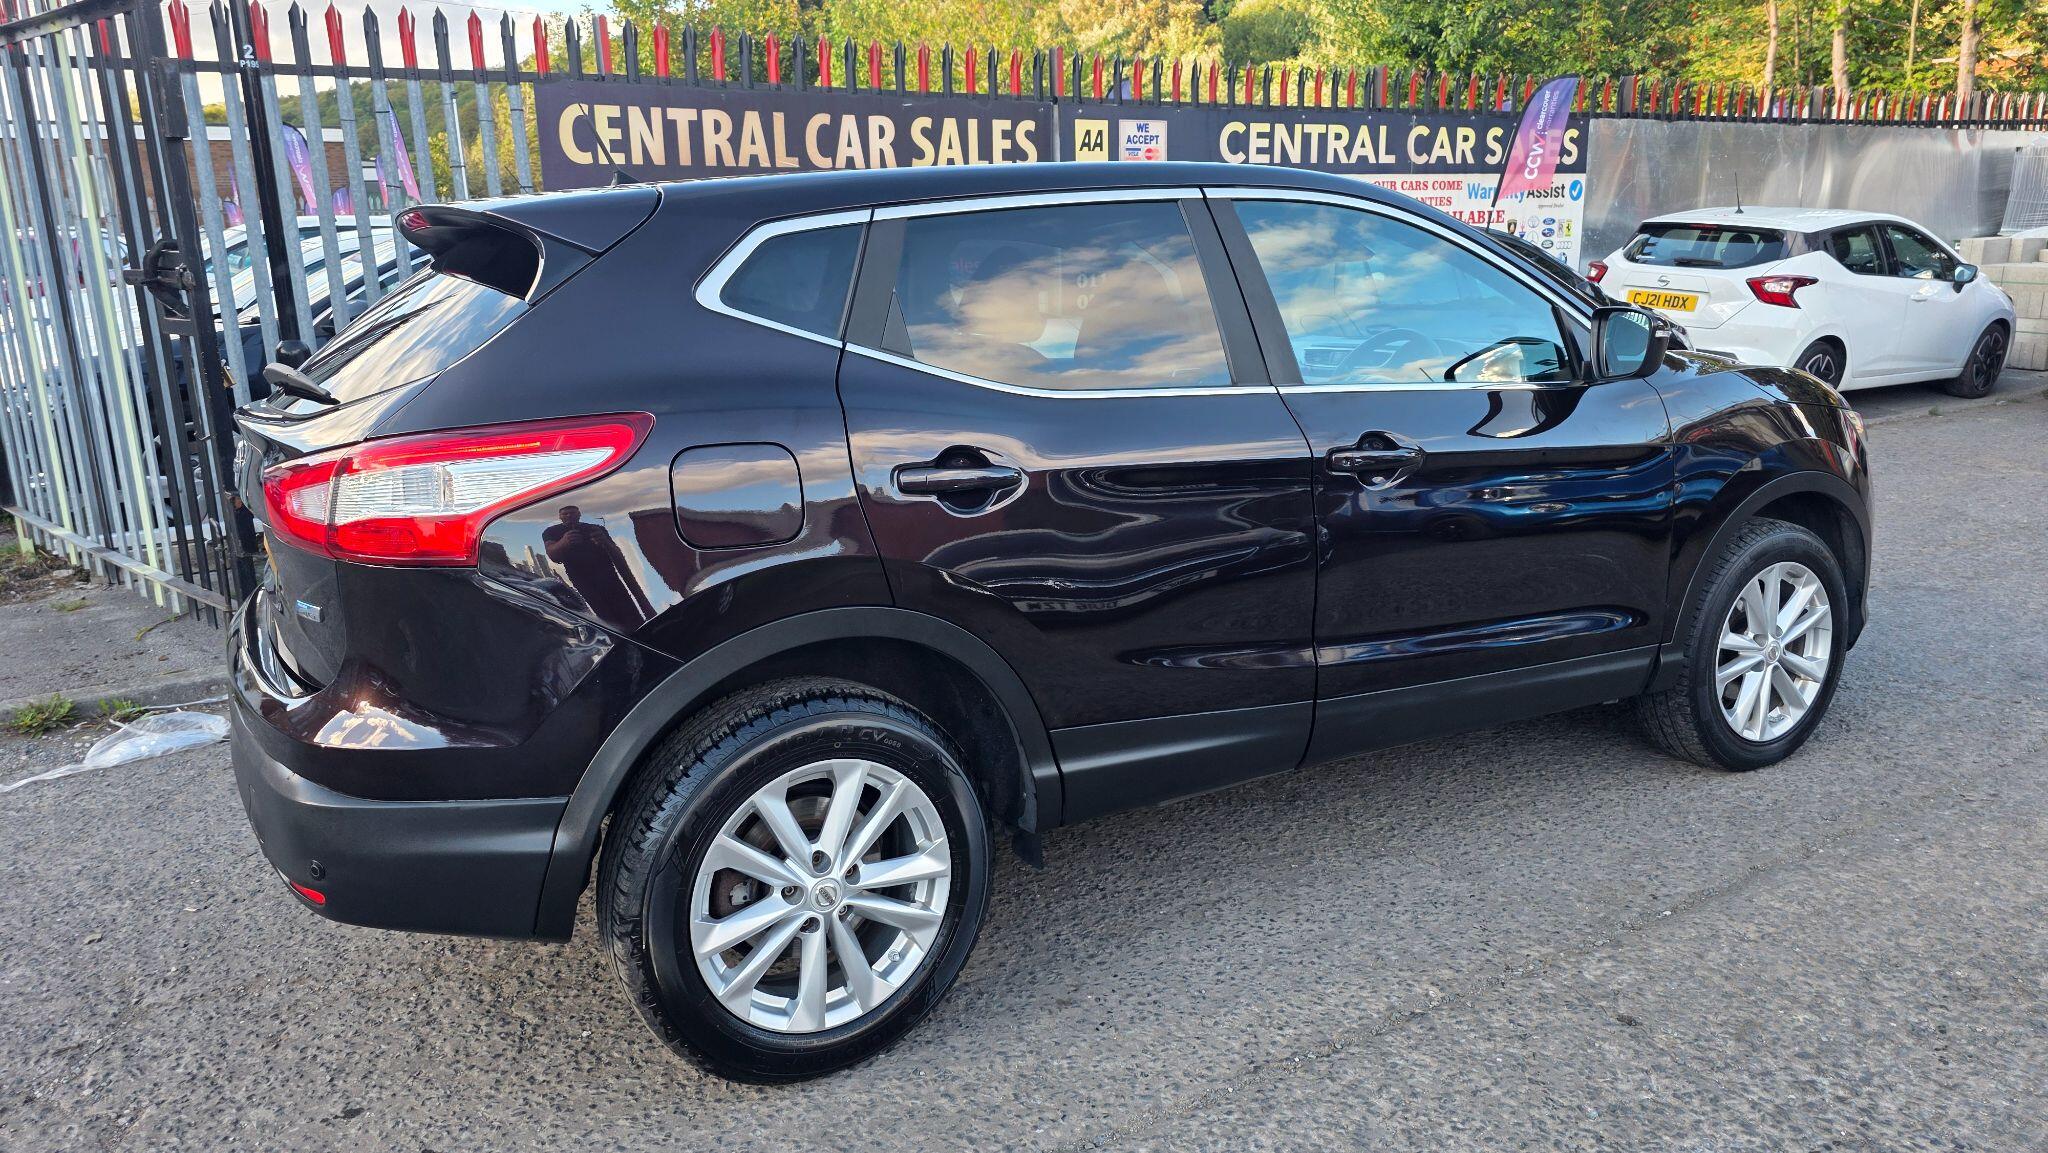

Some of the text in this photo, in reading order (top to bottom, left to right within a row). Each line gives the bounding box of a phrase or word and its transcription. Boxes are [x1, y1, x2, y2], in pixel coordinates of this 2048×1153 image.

[243, 44, 255, 59] 2
[1537, 90, 1551, 130] clearcover
[558, 103, 1038, 170] CENTRAL CAR SALES
[1136, 123, 1150, 133] WE
[1079, 129, 1103, 152] AA
[1126, 134, 1160, 145] ACCEPT
[1219, 121, 1396, 164] CENTRAL
[1407, 125, 1475, 165] CAR
[1401, 180, 1429, 191] CARS
[1432, 180, 1463, 191] COME
[1633, 292, 1690, 309] CJ21 HDX
